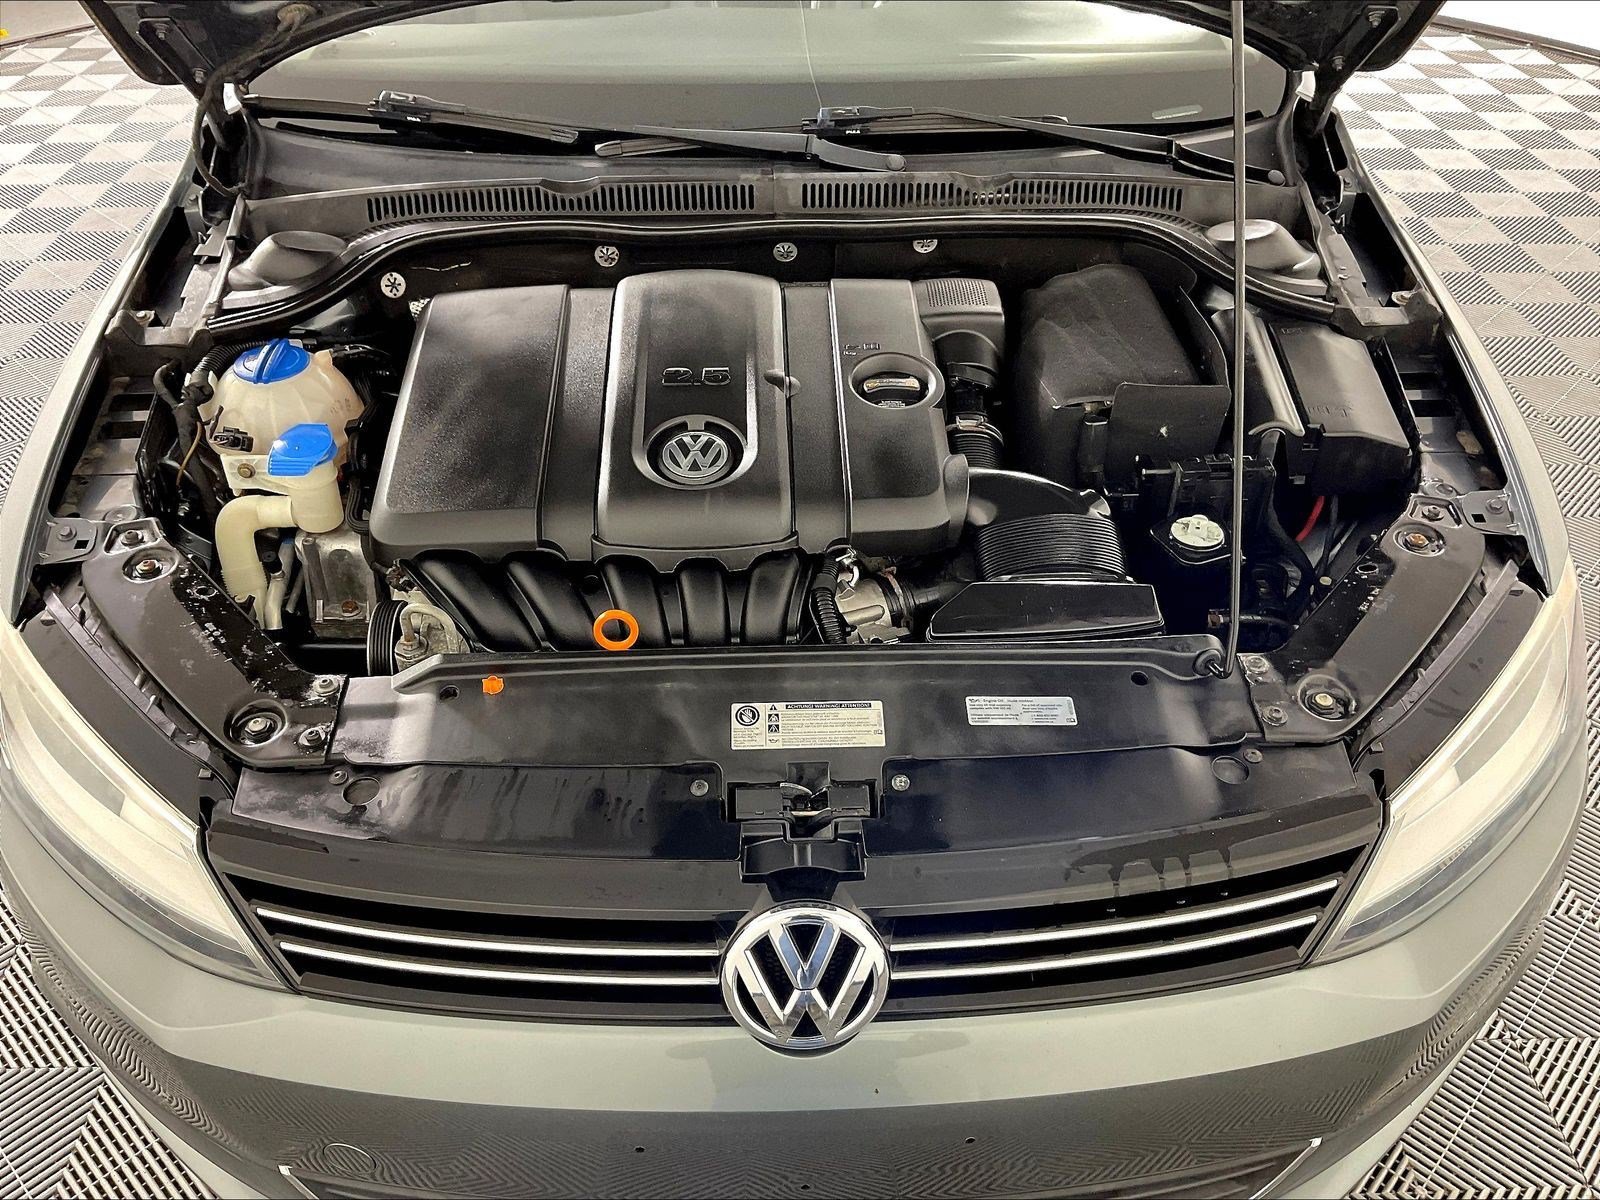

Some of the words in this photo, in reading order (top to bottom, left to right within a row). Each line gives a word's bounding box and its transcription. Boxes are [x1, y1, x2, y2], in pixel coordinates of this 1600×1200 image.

[661, 366, 731, 386] 2.5
[663, 432, 727, 477] VW
[724, 903, 887, 1047] VW
